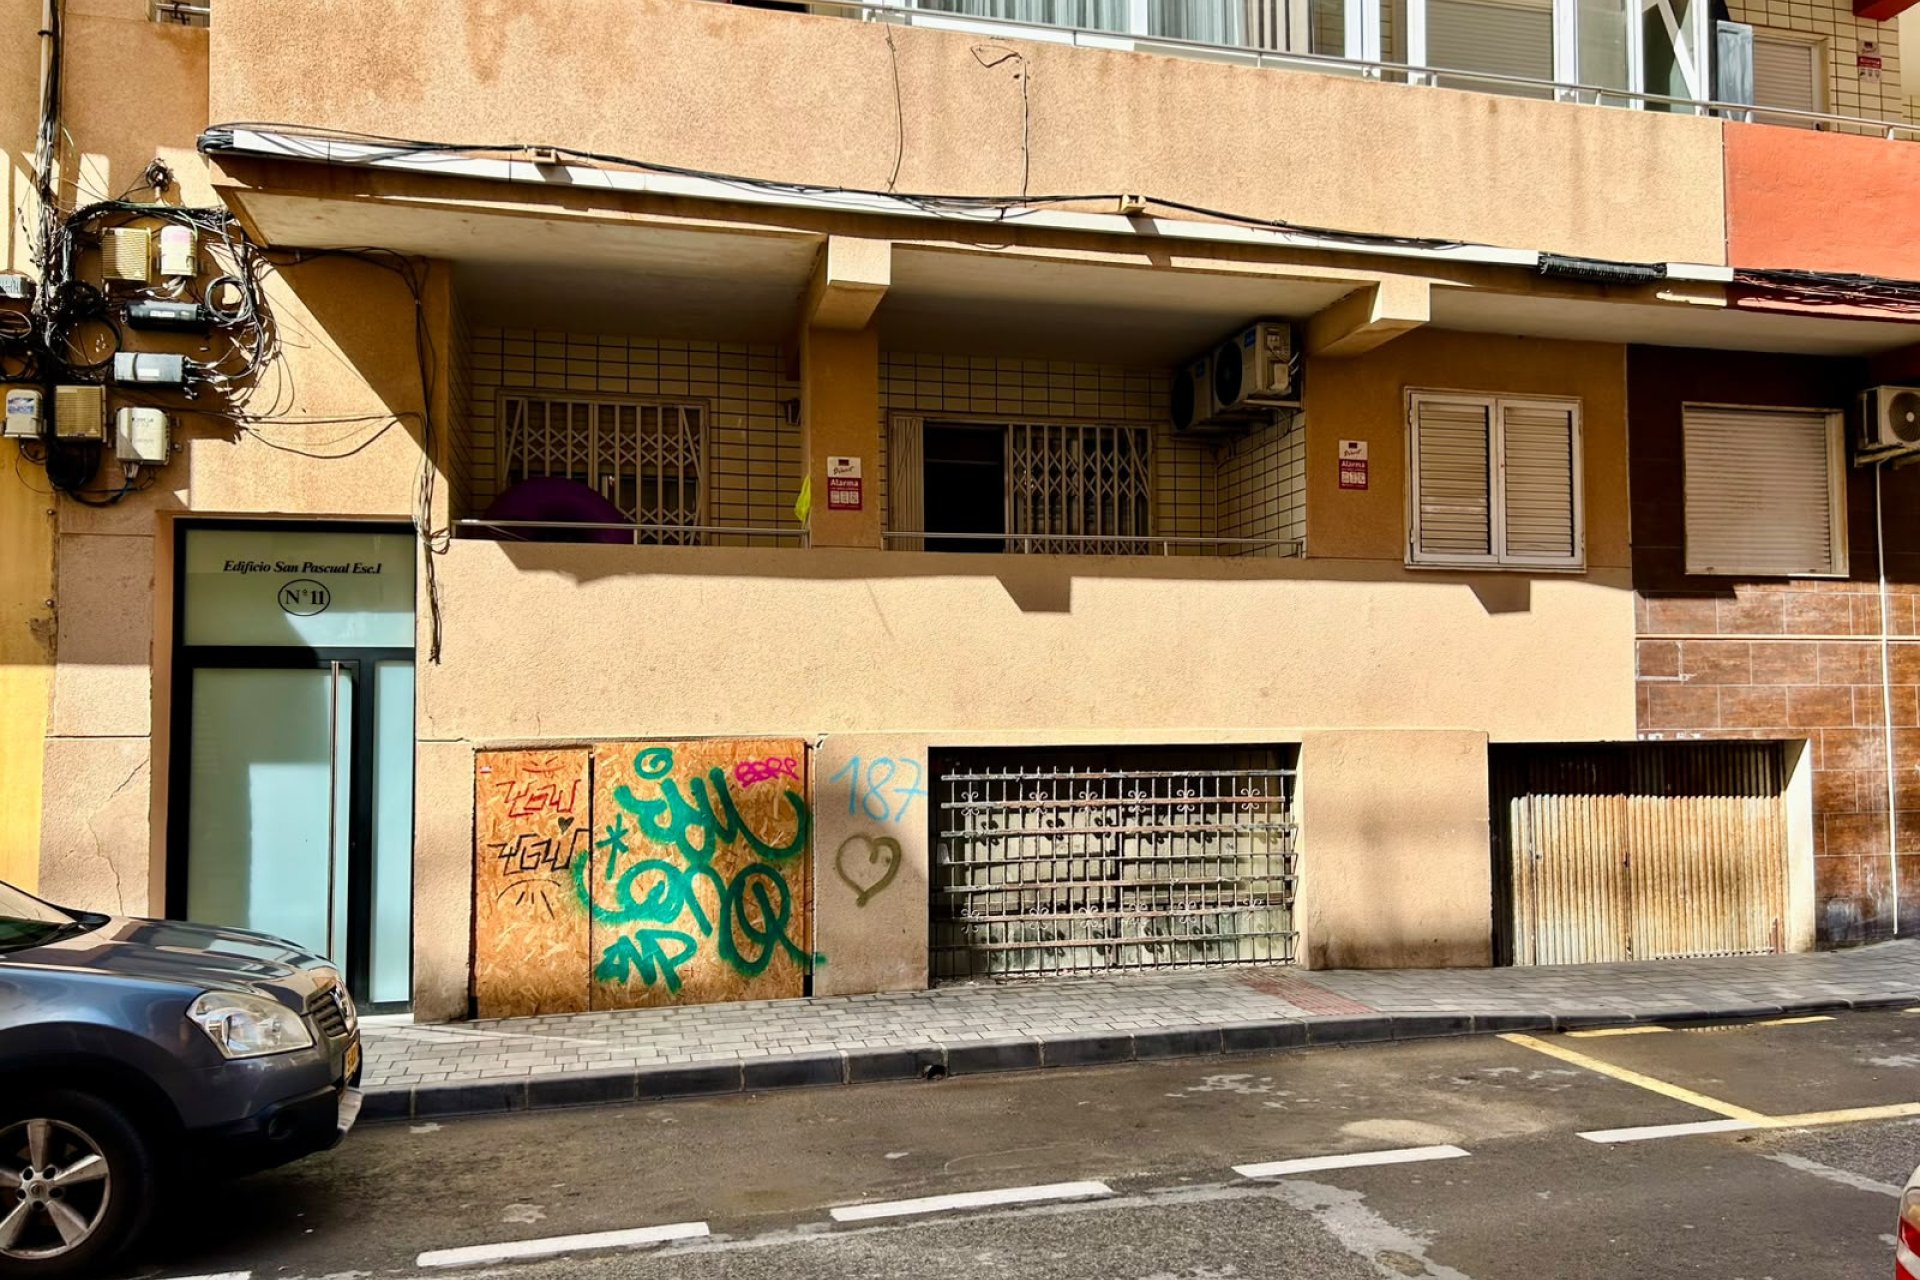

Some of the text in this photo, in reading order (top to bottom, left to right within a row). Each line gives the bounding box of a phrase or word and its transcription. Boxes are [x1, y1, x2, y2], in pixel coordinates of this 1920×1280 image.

[1341, 460, 1365, 468] Alarma
[223, 560, 271, 575] Edificio
[273, 561, 299, 574] San
[302, 562, 350, 574] Pascual
[829, 755, 929, 823] 187
